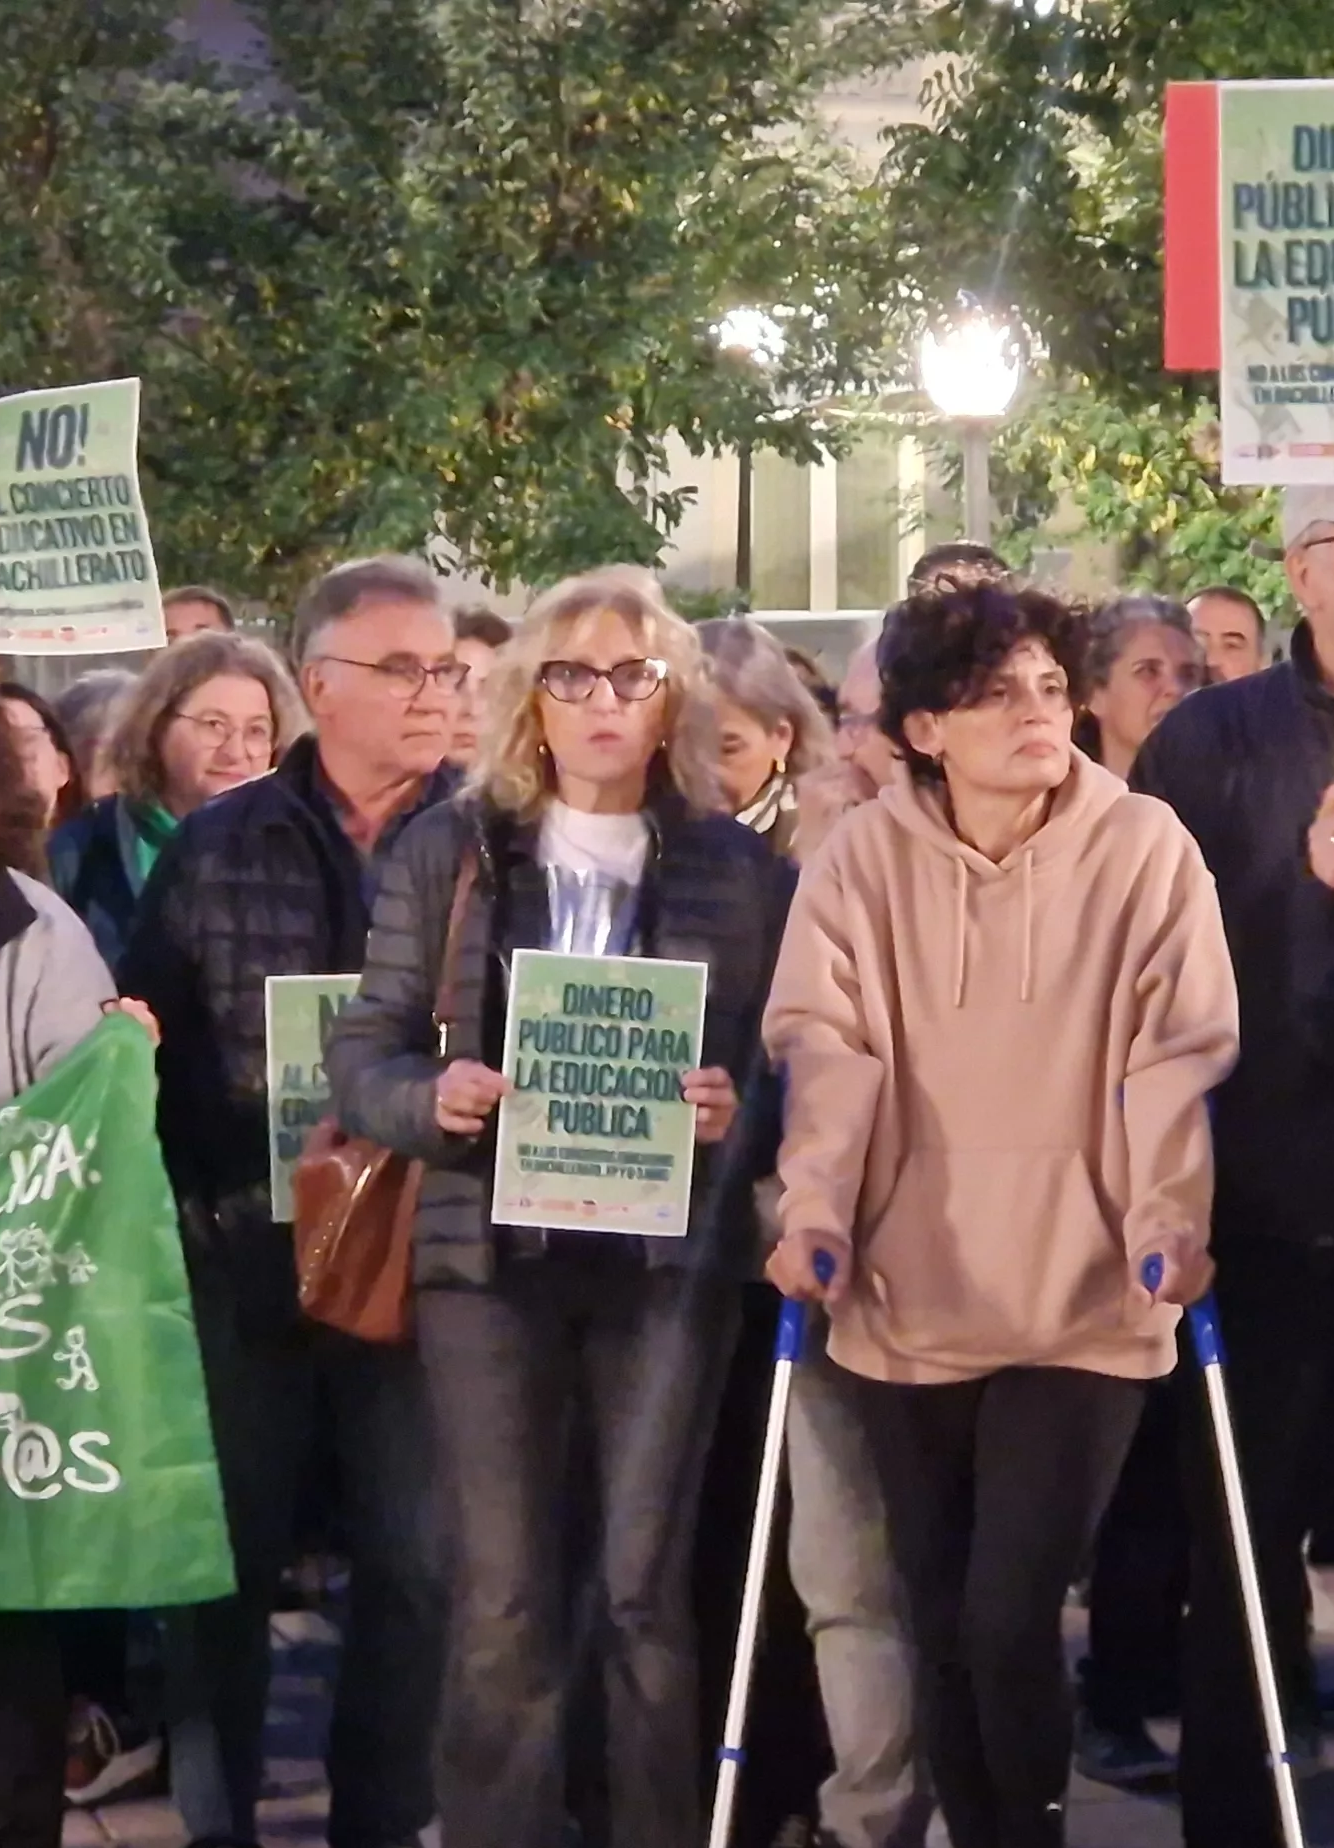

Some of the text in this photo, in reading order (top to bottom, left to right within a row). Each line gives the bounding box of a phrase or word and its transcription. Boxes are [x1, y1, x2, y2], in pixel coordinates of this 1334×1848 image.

[1233, 240, 1276, 287] LA
[16, 402, 90, 472] NO!
[9, 474, 130, 514] CONCIERTO
[108, 512, 140, 544] EN
[563, 983, 654, 1021] DINERO
[519, 1013, 690, 1063] PÚBLICO PARA
[514, 1058, 543, 1091] LA
